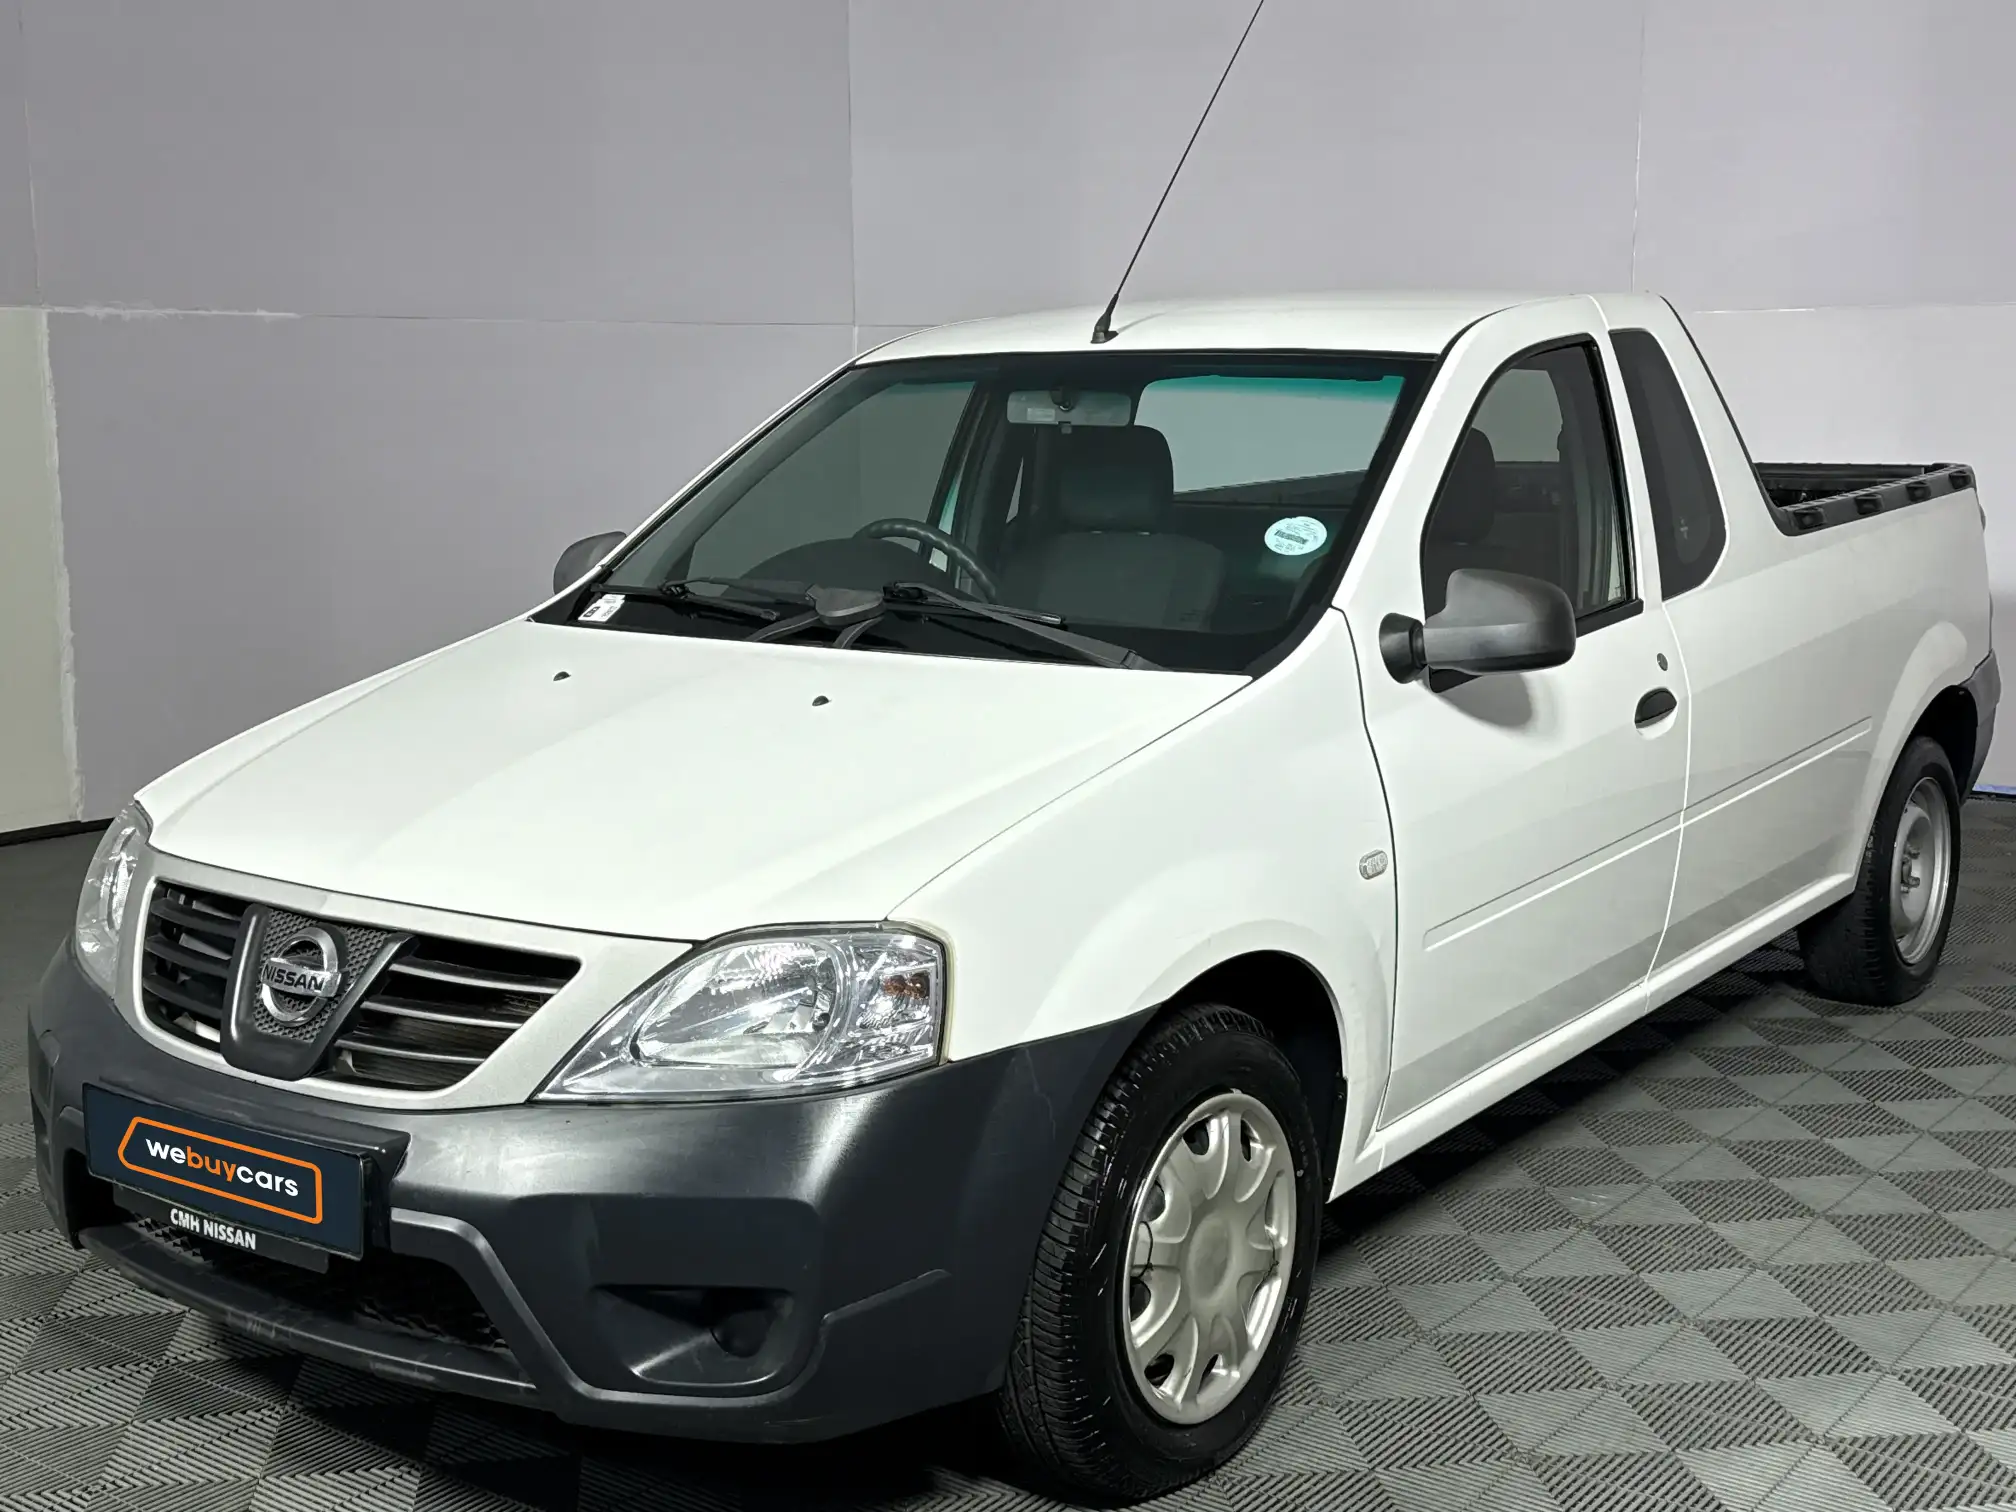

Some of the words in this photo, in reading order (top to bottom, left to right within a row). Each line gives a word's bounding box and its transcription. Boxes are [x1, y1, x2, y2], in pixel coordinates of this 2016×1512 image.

[262, 963, 325, 991] NISSAN
[145, 1138, 298, 1197] webuycars
[170, 1207, 200, 1234] CMH
[203, 1219, 256, 1250] NISSAN
